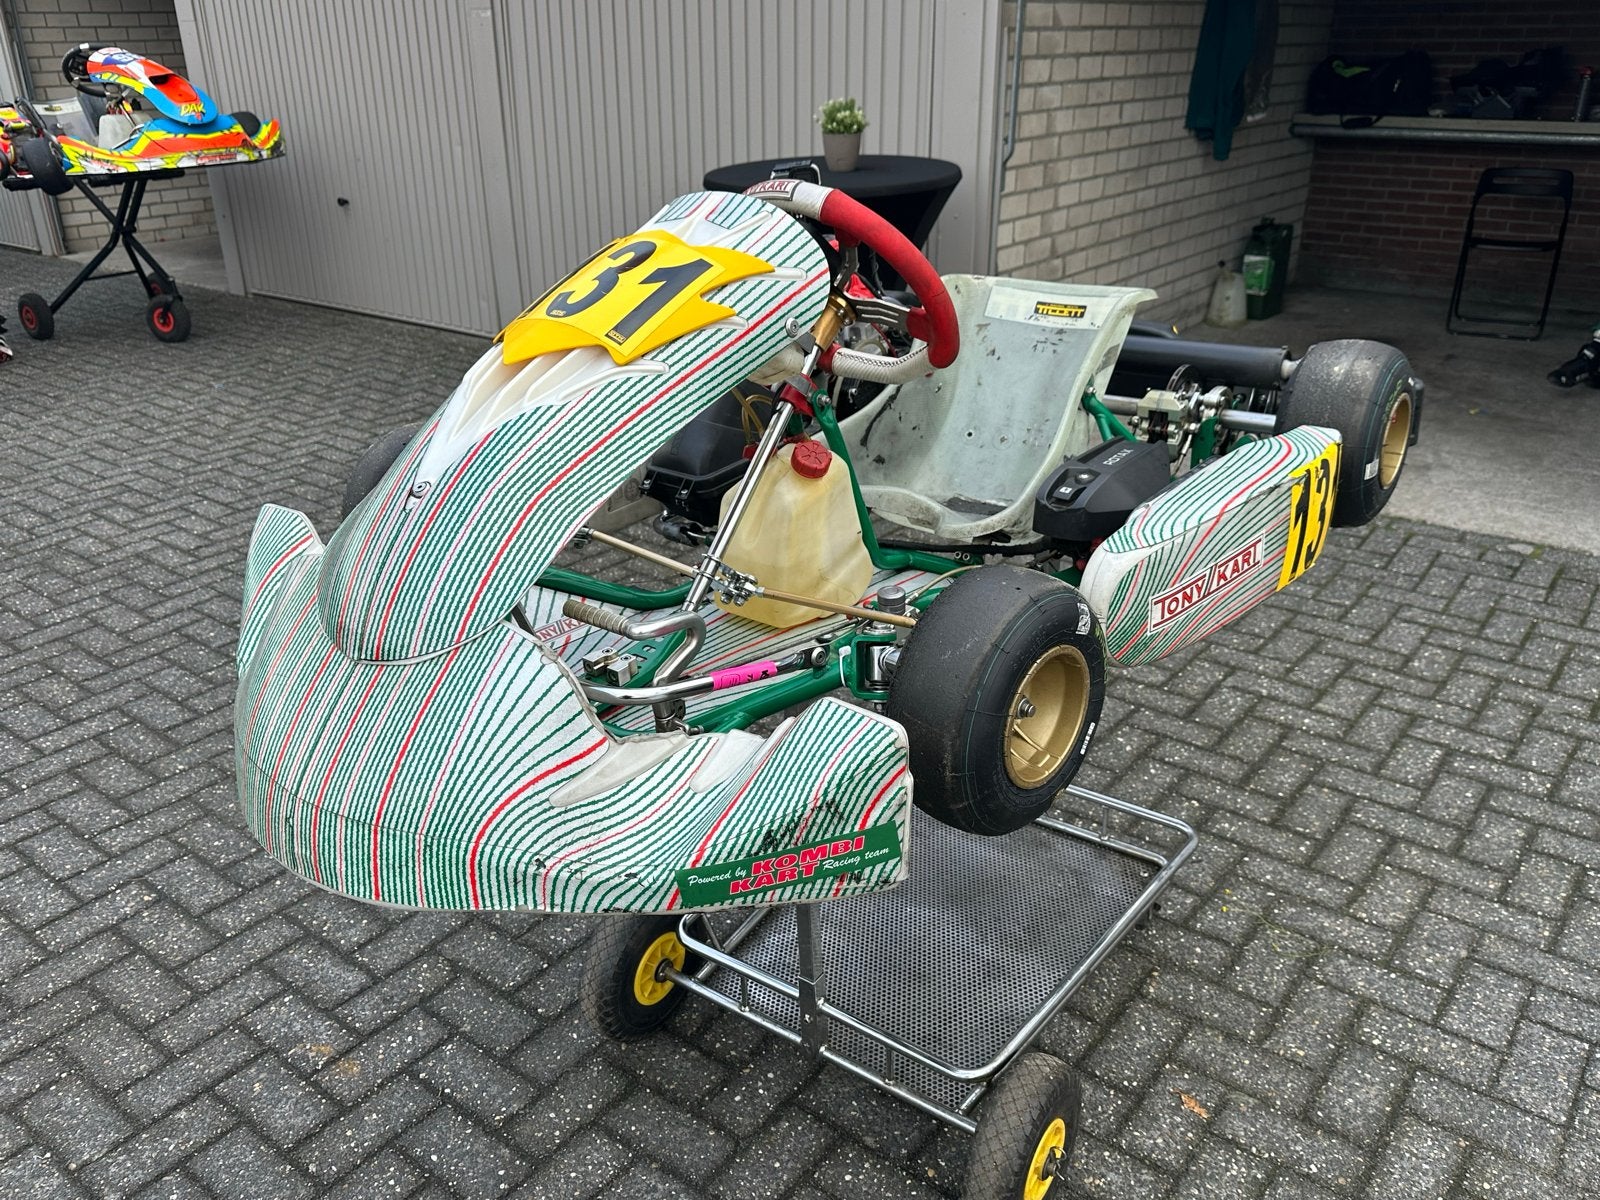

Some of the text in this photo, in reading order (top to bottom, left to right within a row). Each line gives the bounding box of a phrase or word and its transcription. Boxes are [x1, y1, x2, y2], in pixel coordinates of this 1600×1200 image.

[530, 240, 713, 345] 31
[1102, 448, 1134, 466] ROTAX
[1153, 538, 1262, 620] TONY KART
[751, 835, 866, 877] KOMBI
[822, 847, 890, 871] Racing team
[687, 868, 747, 887] Powered by
[729, 862, 820, 894] KART
